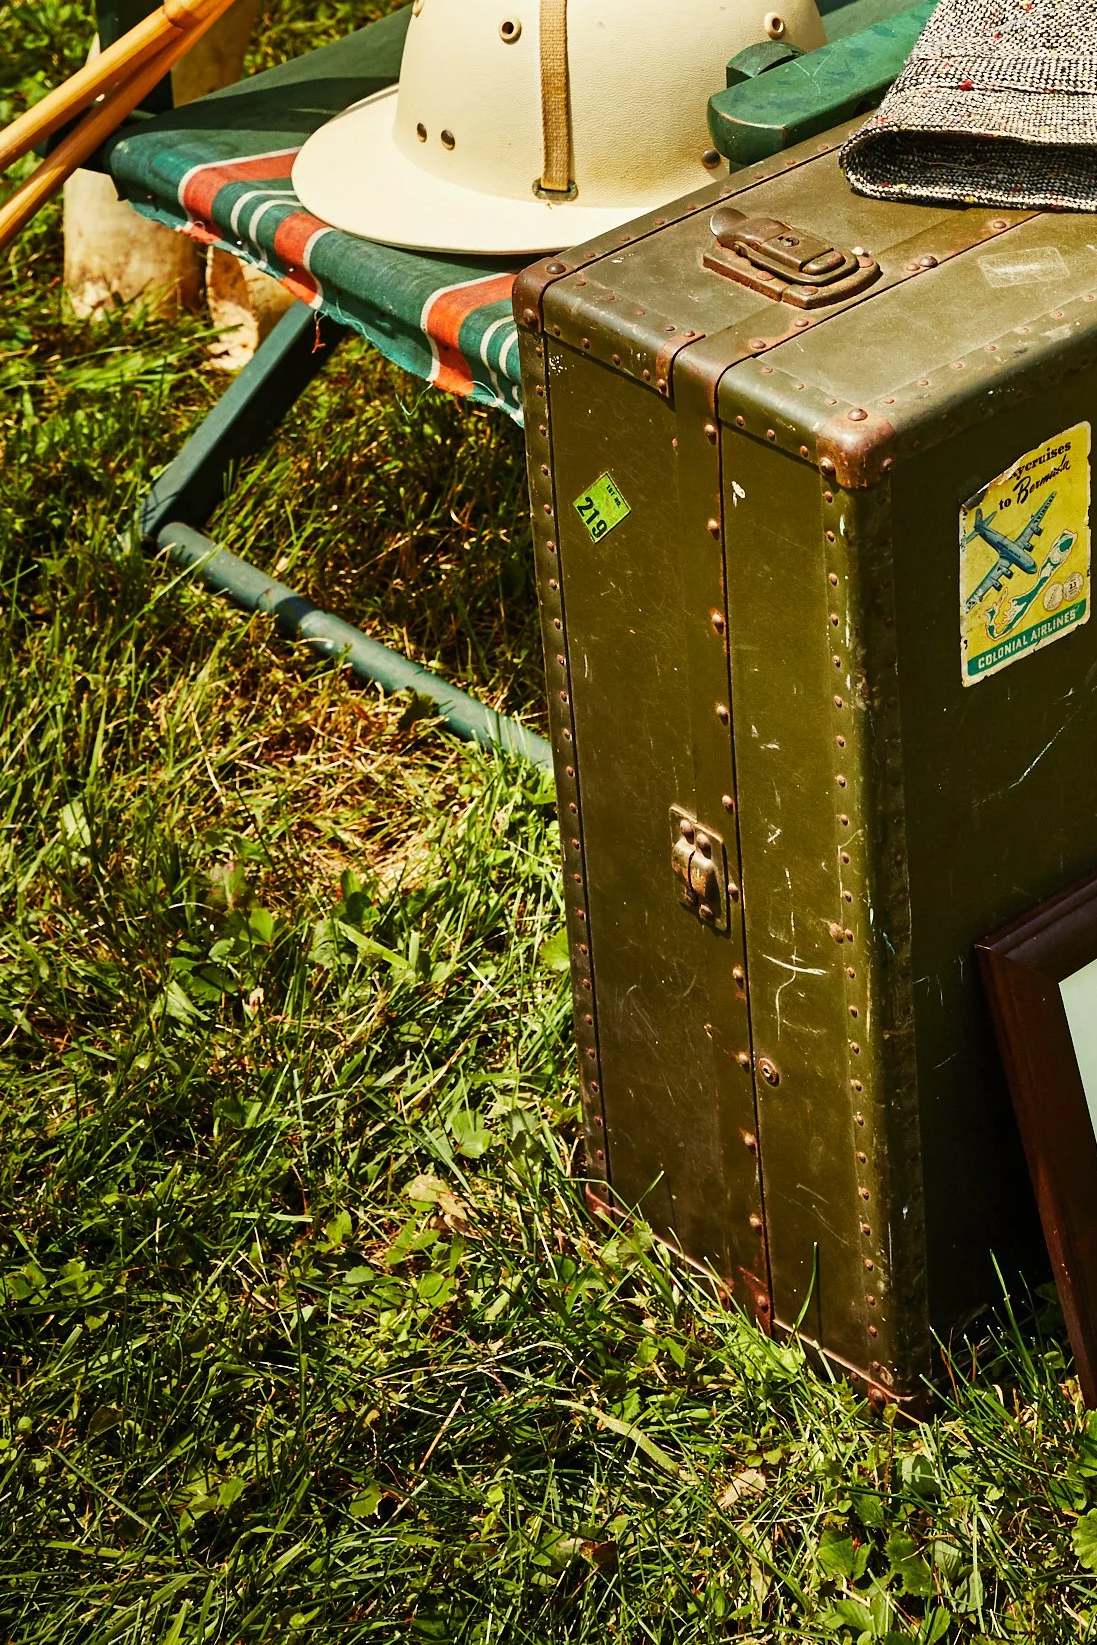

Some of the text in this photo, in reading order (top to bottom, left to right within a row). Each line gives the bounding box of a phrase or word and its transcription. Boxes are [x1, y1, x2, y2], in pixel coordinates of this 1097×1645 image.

[999, 454, 1071, 511] to Bermuda
[1009, 441, 1072, 481] ycruises
[576, 496, 608, 538] 219
[977, 611, 1077, 670] COLONIAL AIRLINES
